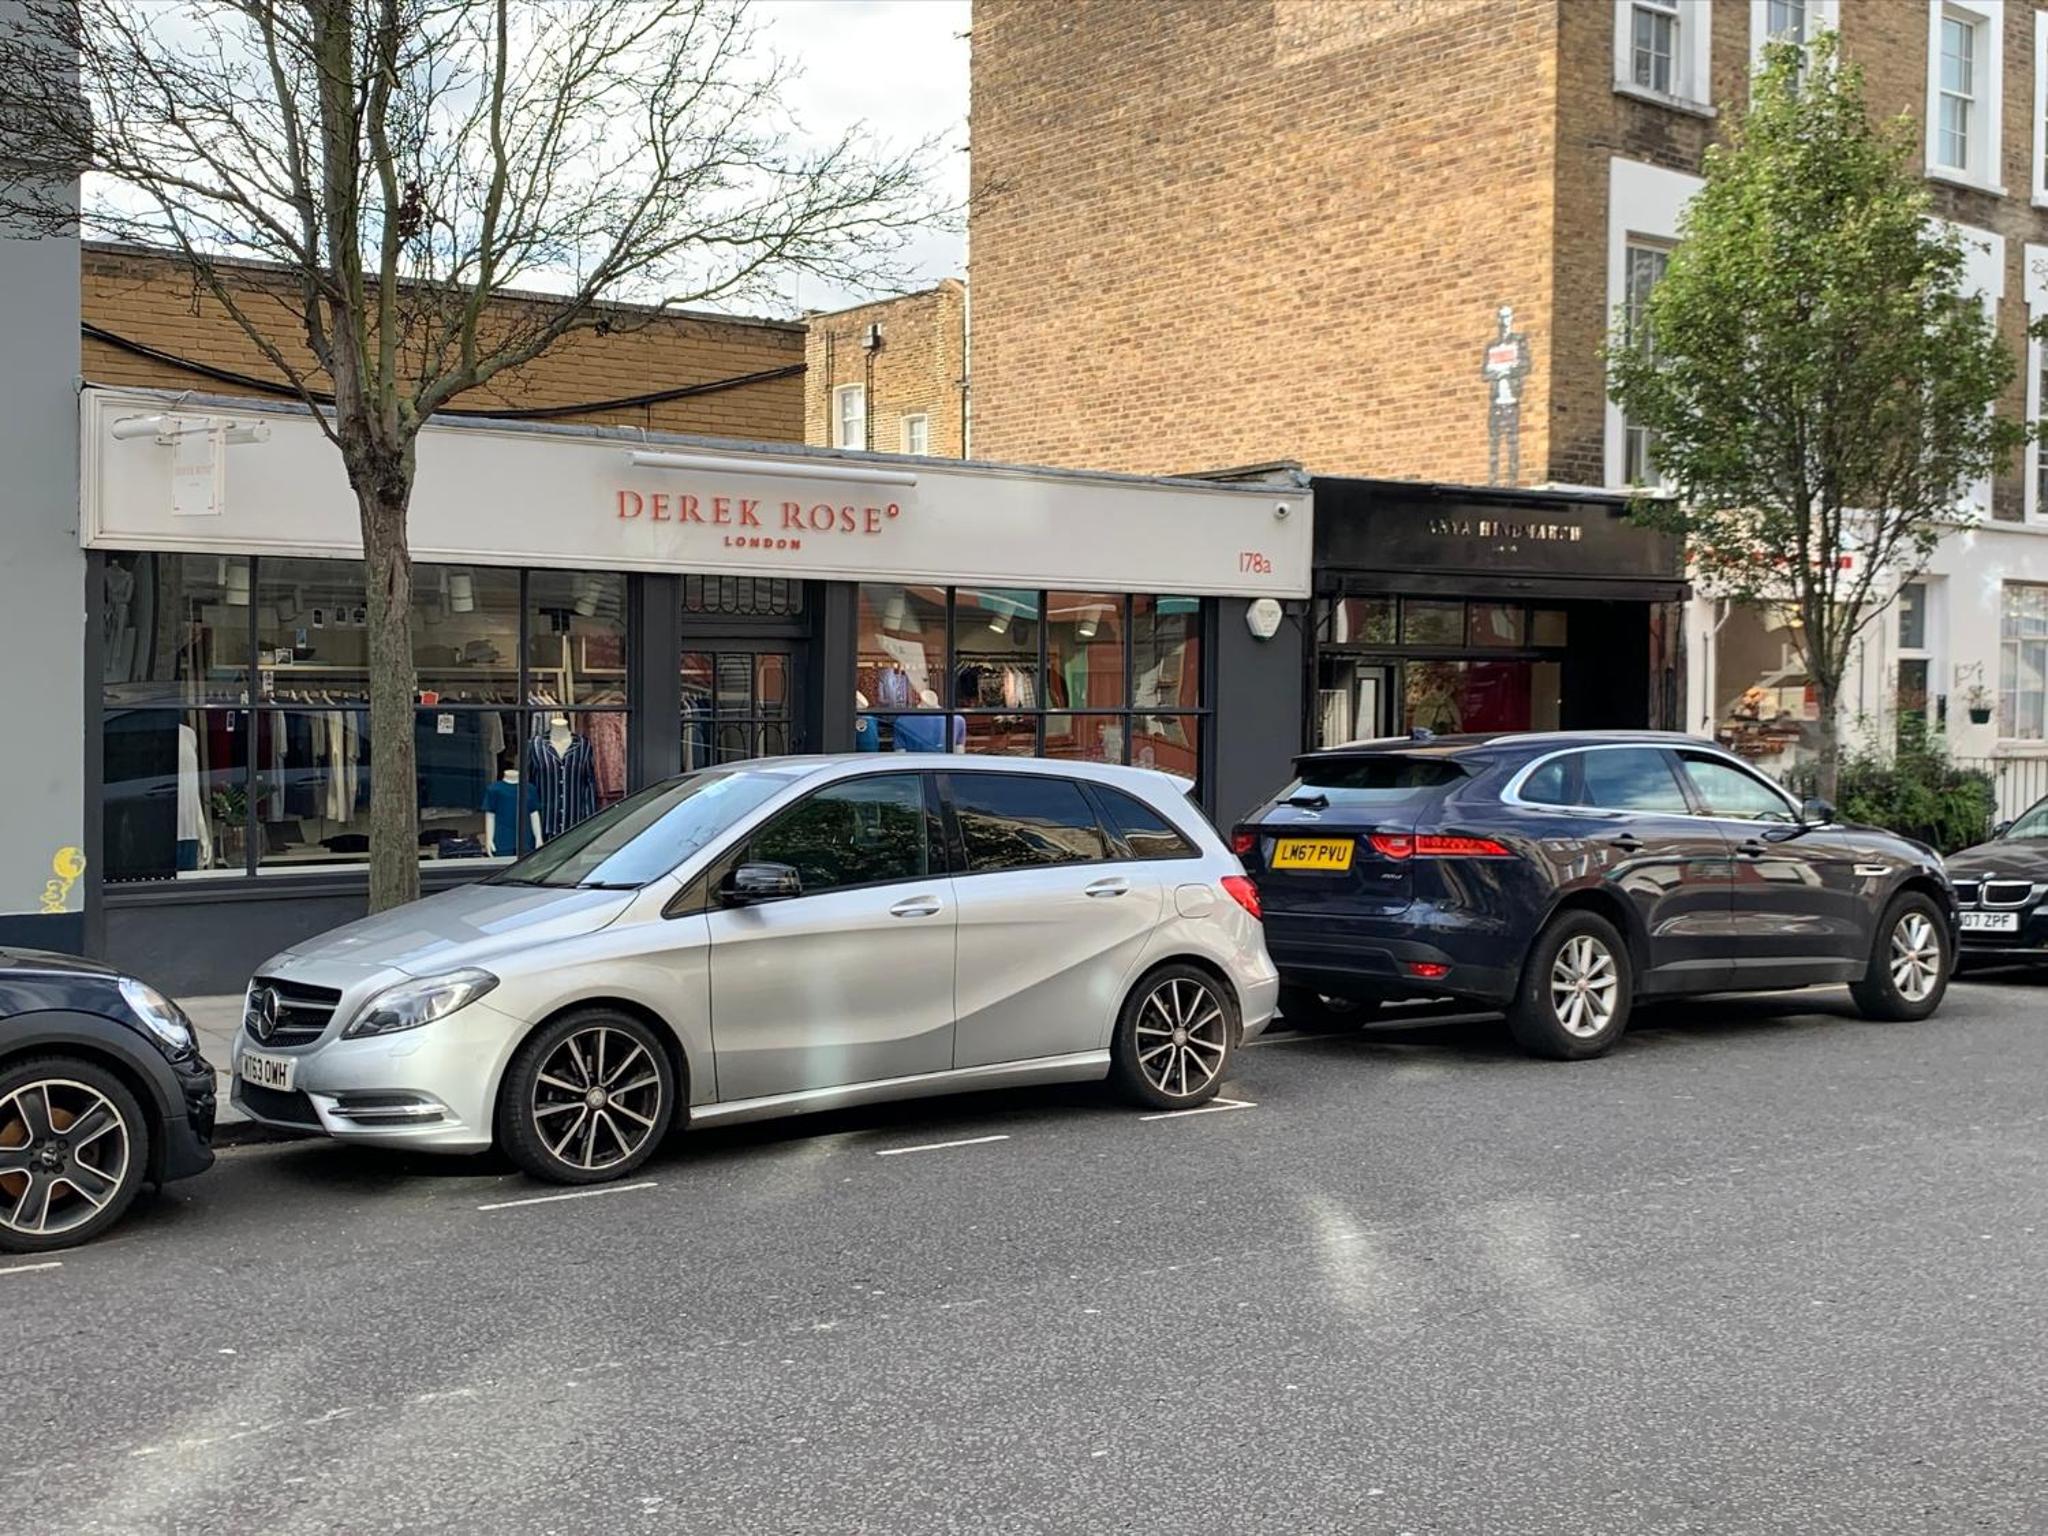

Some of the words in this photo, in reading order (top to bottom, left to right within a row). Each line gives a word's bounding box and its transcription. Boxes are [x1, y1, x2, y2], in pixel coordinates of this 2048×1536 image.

[616, 490, 762, 526] DEREK
[724, 536, 801, 550] LONDON
[1240, 552, 1271, 573] 178a
[1317, 845, 1348, 862] PVU
[1984, 914, 2010, 927] ZPF
